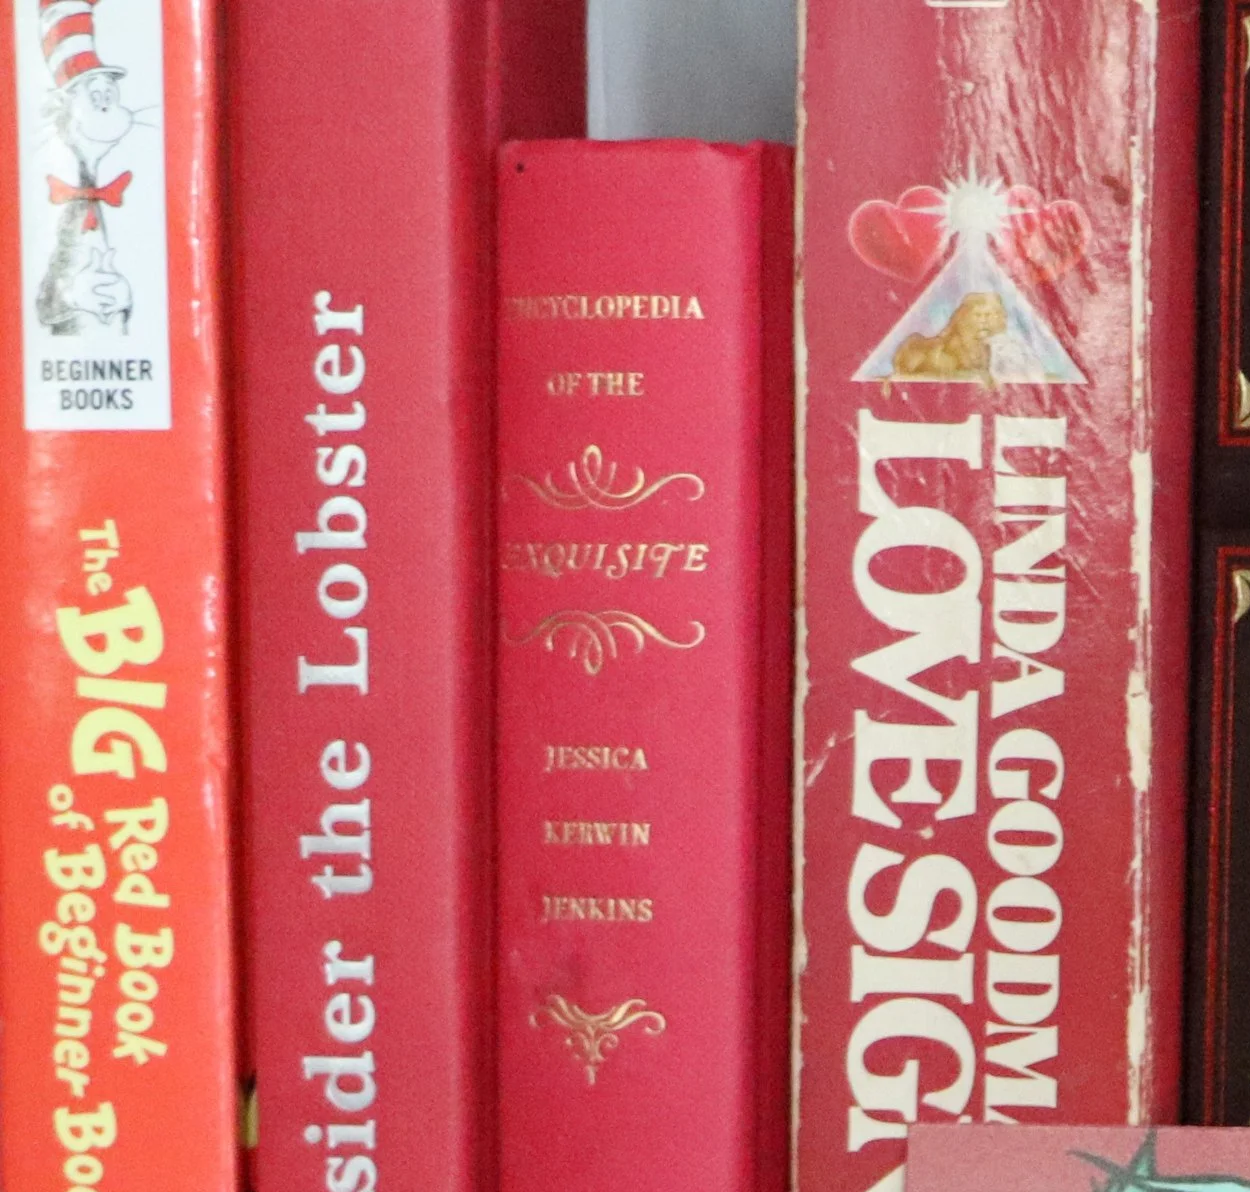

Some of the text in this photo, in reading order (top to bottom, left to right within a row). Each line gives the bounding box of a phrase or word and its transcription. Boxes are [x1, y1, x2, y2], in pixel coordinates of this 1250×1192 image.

[505, 296, 705, 320] NCYCLOPEDIA
[42, 359, 152, 381] BEGINNER
[547, 372, 643, 395] OF THE
[60, 388, 133, 410] BOOKS
[295, 291, 368, 694] Lobster
[79, 519, 119, 595] The
[502, 543, 710, 579] XQUISITE
[852, 413, 982, 828] LOVE
[57, 587, 167, 778] BIG
[546, 746, 648, 771] JESSICA
[986, 414, 1067, 1123] LINDA GOODM
[48, 784, 94, 831] of
[299, 740, 372, 898] the
[546, 822, 650, 846] KERWIN
[104, 798, 174, 1064] Red Book
[544, 897, 653, 922] JENKINS
[43, 845, 106, 1097] Beginner
